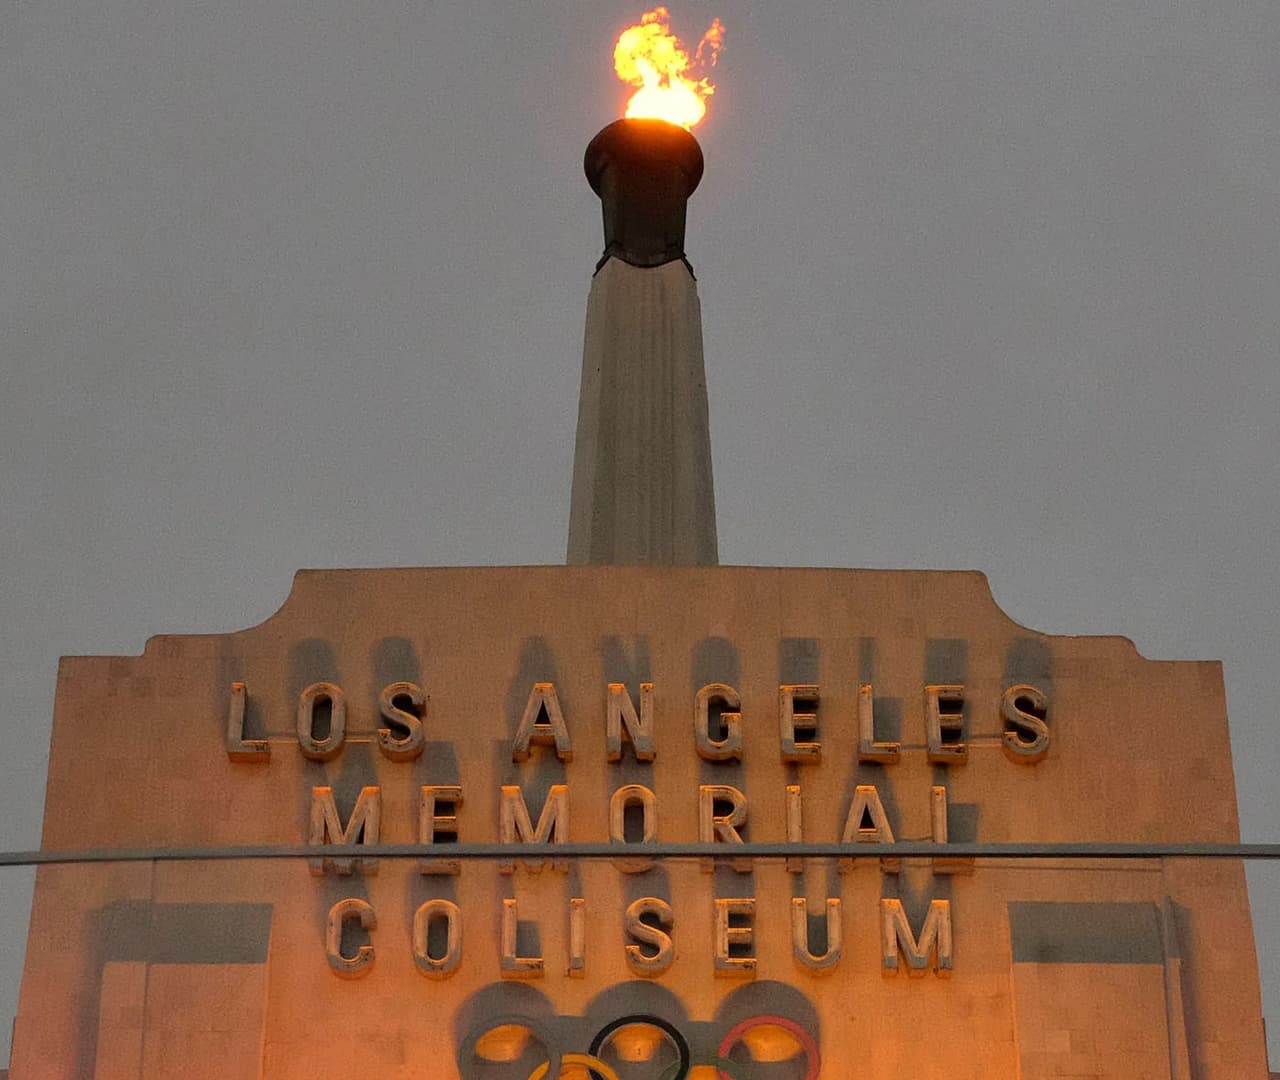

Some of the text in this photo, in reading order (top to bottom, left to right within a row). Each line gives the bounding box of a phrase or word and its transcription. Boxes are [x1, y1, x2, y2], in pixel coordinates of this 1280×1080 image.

[227, 681, 1052, 765] LOS ANGELES
[310, 784, 976, 877] MEMORIAL
[325, 897, 955, 979] COLISEUM
